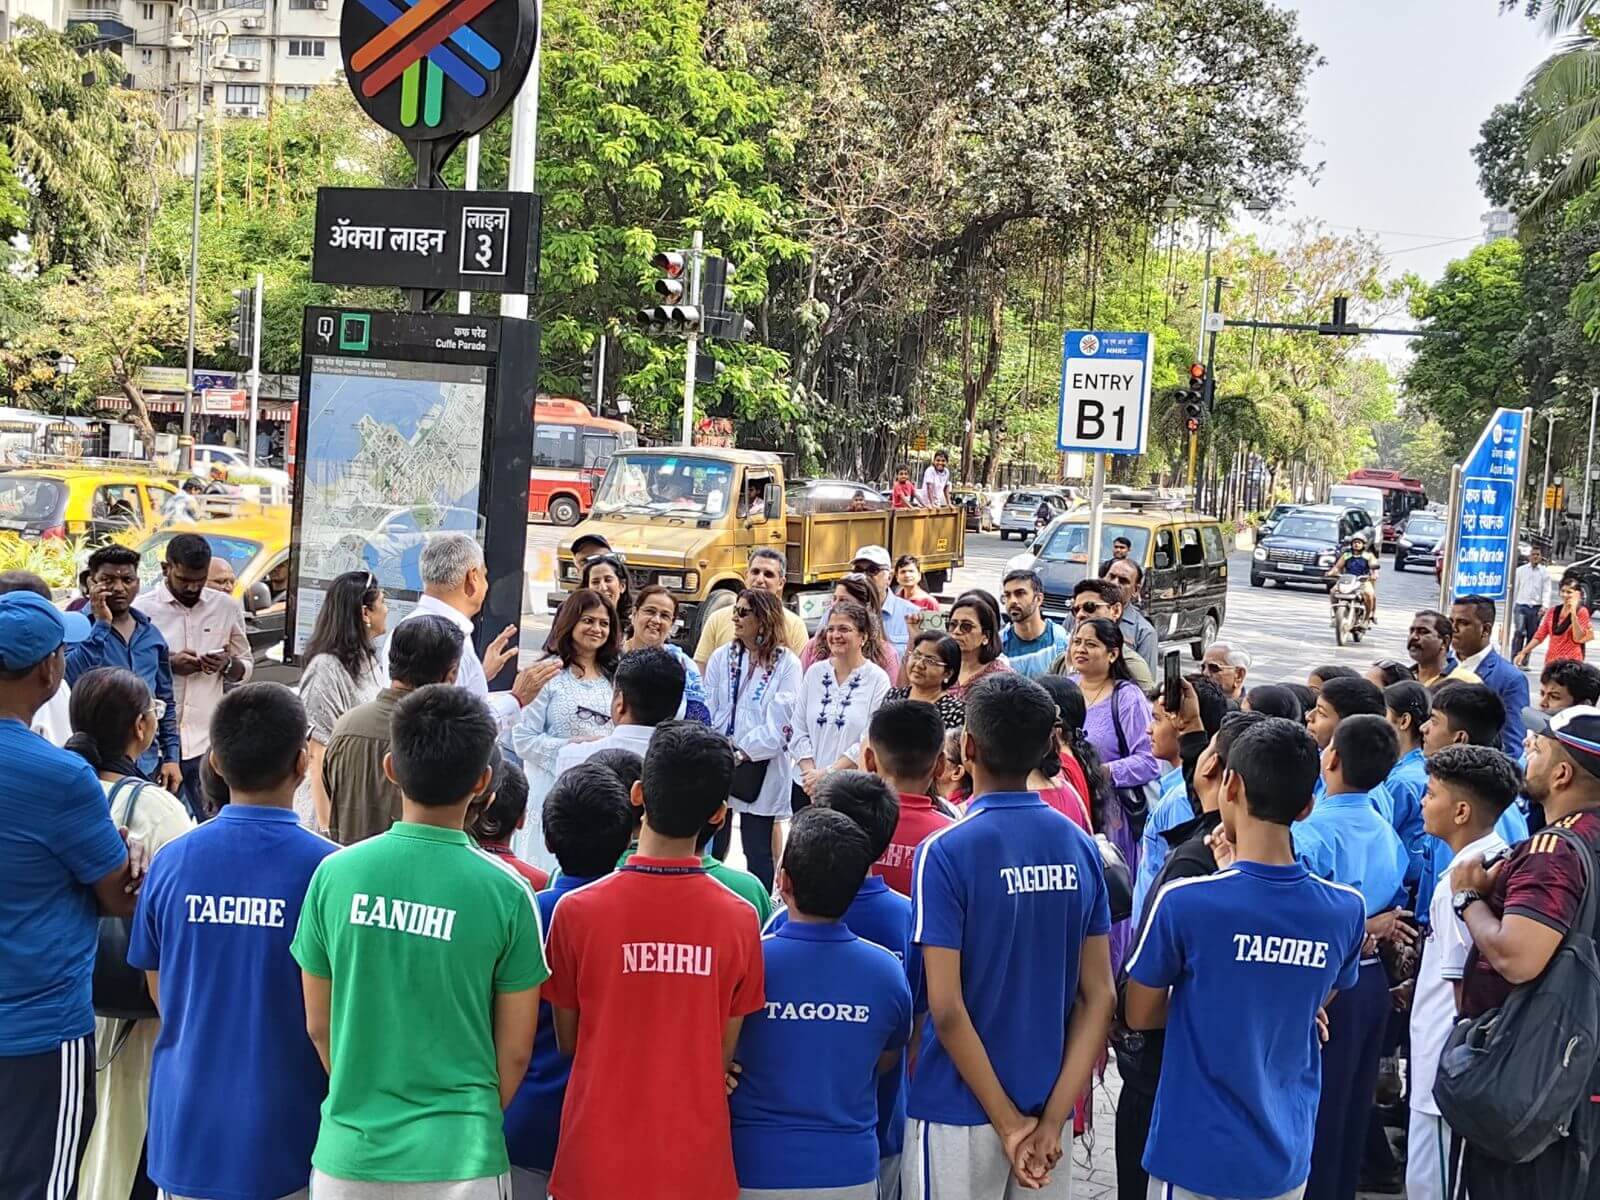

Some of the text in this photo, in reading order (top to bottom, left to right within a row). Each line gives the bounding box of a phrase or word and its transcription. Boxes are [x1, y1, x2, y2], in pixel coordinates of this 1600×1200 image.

[465, 212, 506, 232] लाइन
[389, 228, 447, 256] लाइन
[475, 234, 493, 268] ३
[435, 338, 487, 351] Cuffe Parade
[454, 325, 488, 339] कफ परेड
[1072, 373, 1134, 391] ENTRY
[1076, 399, 1125, 442] B1
[1459, 546, 1505, 563] Cuffe Parade
[1456, 571, 1502, 587] Metro Station
[1000, 864, 1078, 895] TAGORE
[185, 894, 286, 928] TAGORE
[350, 893, 457, 942] GANDHI
[621, 942, 712, 976] NEHRU
[1233, 933, 1329, 969] TAGORE
[764, 1001, 870, 1023] TAGORE
